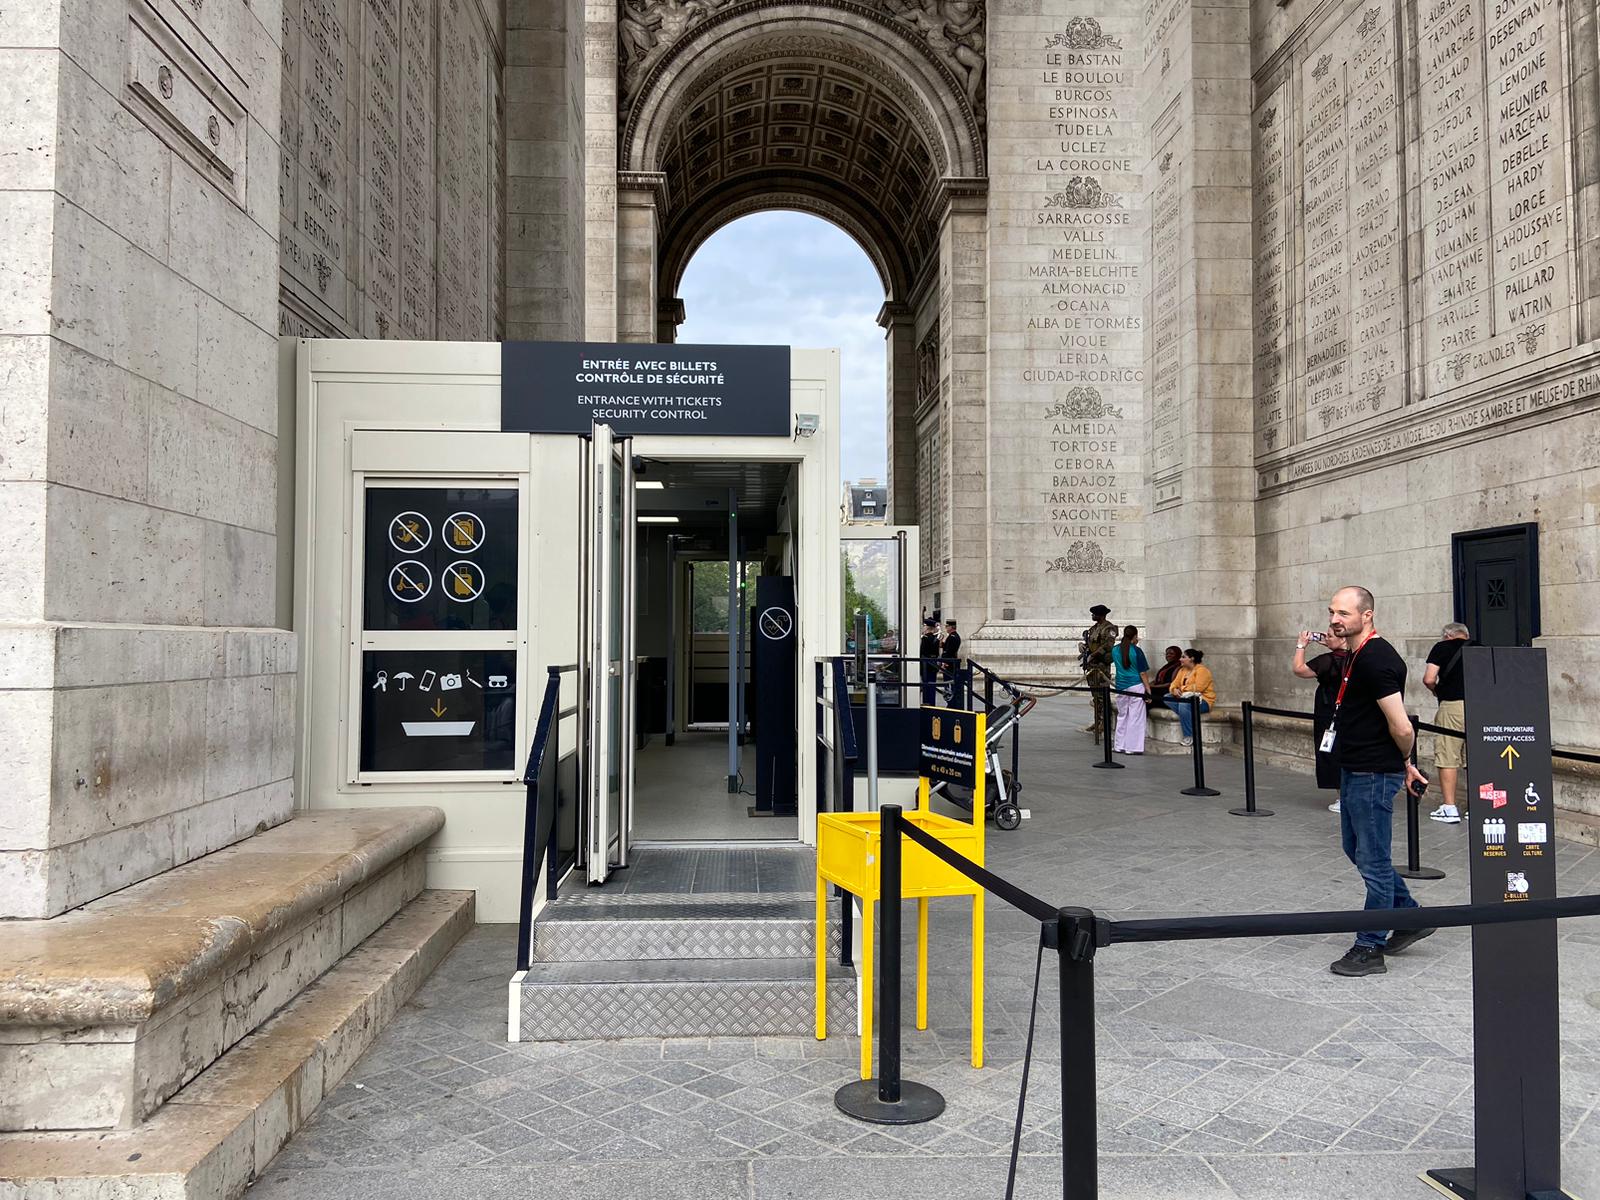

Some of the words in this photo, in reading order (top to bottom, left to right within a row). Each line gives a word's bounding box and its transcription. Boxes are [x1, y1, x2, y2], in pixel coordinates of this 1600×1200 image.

[1428, 4, 1472, 48] TAPONIER
[1046, 54, 1061, 65] LE
[1068, 54, 1121, 66] BASTAN
[1427, 26, 1475, 76] LAMARCHE
[1499, 24, 1545, 70] MORLOT
[1043, 72, 1058, 83] LE
[1065, 72, 1124, 84] BOULOU
[1433, 57, 1470, 94] COLAUD
[1500, 51, 1546, 96] LEMOINE
[1055, 90, 1112, 101] BURGOS
[1437, 83, 1467, 115] HATRY
[1500, 80, 1549, 123] MEUNIER
[1049, 107, 1118, 119] ESPINOSA
[1306, 94, 1341, 134] LAFAYETTE
[1432, 106, 1473, 143] DUFOUR
[1500, 103, 1551, 149] MARCEAU
[1055, 124, 1113, 136] TUDELA
[1355, 120, 1389, 157] MIRANDA
[1061, 141, 1106, 153] UCLEZ
[1305, 137, 1344, 175] KELLERMANN
[1355, 143, 1388, 177] VALENCE
[1502, 133, 1549, 175] DEBELLE
[1037, 160, 1053, 171] LA
[1059, 159, 1131, 171] COROGNE
[1432, 153, 1476, 191] BONNARD
[1507, 160, 1546, 195] HARDY
[1362, 168, 1383, 193] TILLY
[308, 181, 337, 224] DROUET
[1356, 188, 1390, 221] FERRAND
[1437, 183, 1475, 214] DEJEAN
[1037, 212, 1130, 225] SARRAGOSSE
[1308, 198, 1342, 233] DAMPIERRE
[1359, 209, 1389, 239] CHAZOT
[1435, 201, 1476, 237] SOUHAM
[1496, 206, 1562, 253] LAHOUSSAYE
[304, 210, 341, 260] BERTRAND
[1063, 230, 1104, 242] VALLS
[1312, 223, 1338, 250] CUSTINE
[1353, 227, 1397, 266] LANDREMONT
[1435, 227, 1478, 261] KILMAINE
[1052, 248, 1116, 260] MEDELIN
[1308, 241, 1342, 271] HOUCHARD
[1359, 252, 1390, 281] LANOUE
[1431, 247, 1483, 285] VANDAMME
[1029, 266, 1139, 278] MARIA-BELCHITE
[1309, 262, 1342, 292] LATOUCHE
[1505, 265, 1555, 300] PAILLARD
[1041, 283, 1126, 295] ALMONACID
[1438, 276, 1477, 306] LEMAIRE
[1057, 300, 1110, 312] OCANA
[1311, 305, 1340, 329] JOURDAN
[1356, 293, 1396, 324] DABOVILLE
[1437, 299, 1480, 329] HARVILLE
[1508, 293, 1553, 324] WATRIN
[1027, 317, 1060, 329] ALBA
[1065, 318, 1081, 329] DE
[1313, 323, 1338, 345] HOCHE
[1361, 317, 1391, 343] CARNOT
[1059, 335, 1108, 347] VIQUE
[1363, 342, 1388, 364] DUVAL
[1441, 325, 1477, 352] SPARRE
[583, 357, 629, 370] ENTRÉE
[634, 360, 667, 371] AVEC
[669, 361, 717, 372] BILLETS
[1059, 353, 1109, 365] LERIDA
[1307, 339, 1347, 370] BERNADOTTE
[1472, 341, 1517, 370] GRUNDLER
[575, 371, 644, 384] CONTRÔLE
[646, 374, 663, 384] DE
[666, 371, 724, 385] SÉCURITÉ
[1307, 360, 1347, 387] CHAMPIONNET
[577, 395, 640, 406] ENTRANCE
[642, 396, 674, 406] WITH
[675, 396, 722, 407] TICKETS
[1311, 382, 1343, 406] LEFEBVRE
[592, 409, 648, 420] SECURITY
[650, 409, 707, 420] CONTROL
[1052, 423, 1117, 435] ALMEIDA
[1322, 455, 1338, 469] NORD
[1350, 442, 1381, 461] ARDENNES
[1403, 423, 1434, 447] MOSELLE
[1436, 422, 1446, 437] DU
[1449, 413, 1466, 432] RHIN
[1467, 410, 1478, 427] DE
[1480, 399, 1513, 422] SAMBRE
[1516, 395, 1527, 413] ET
[1529, 384, 1559, 408] MEUSE
[1563, 380, 1575, 399] DE
[1050, 440, 1117, 452] TORTOSE
[1052, 475, 1116, 487] BADAJOZ
[1040, 492, 1127, 504] TARRAGONE
[1052, 509, 1118, 521] SAGONTE
[1053, 526, 1116, 537] VALENCE
